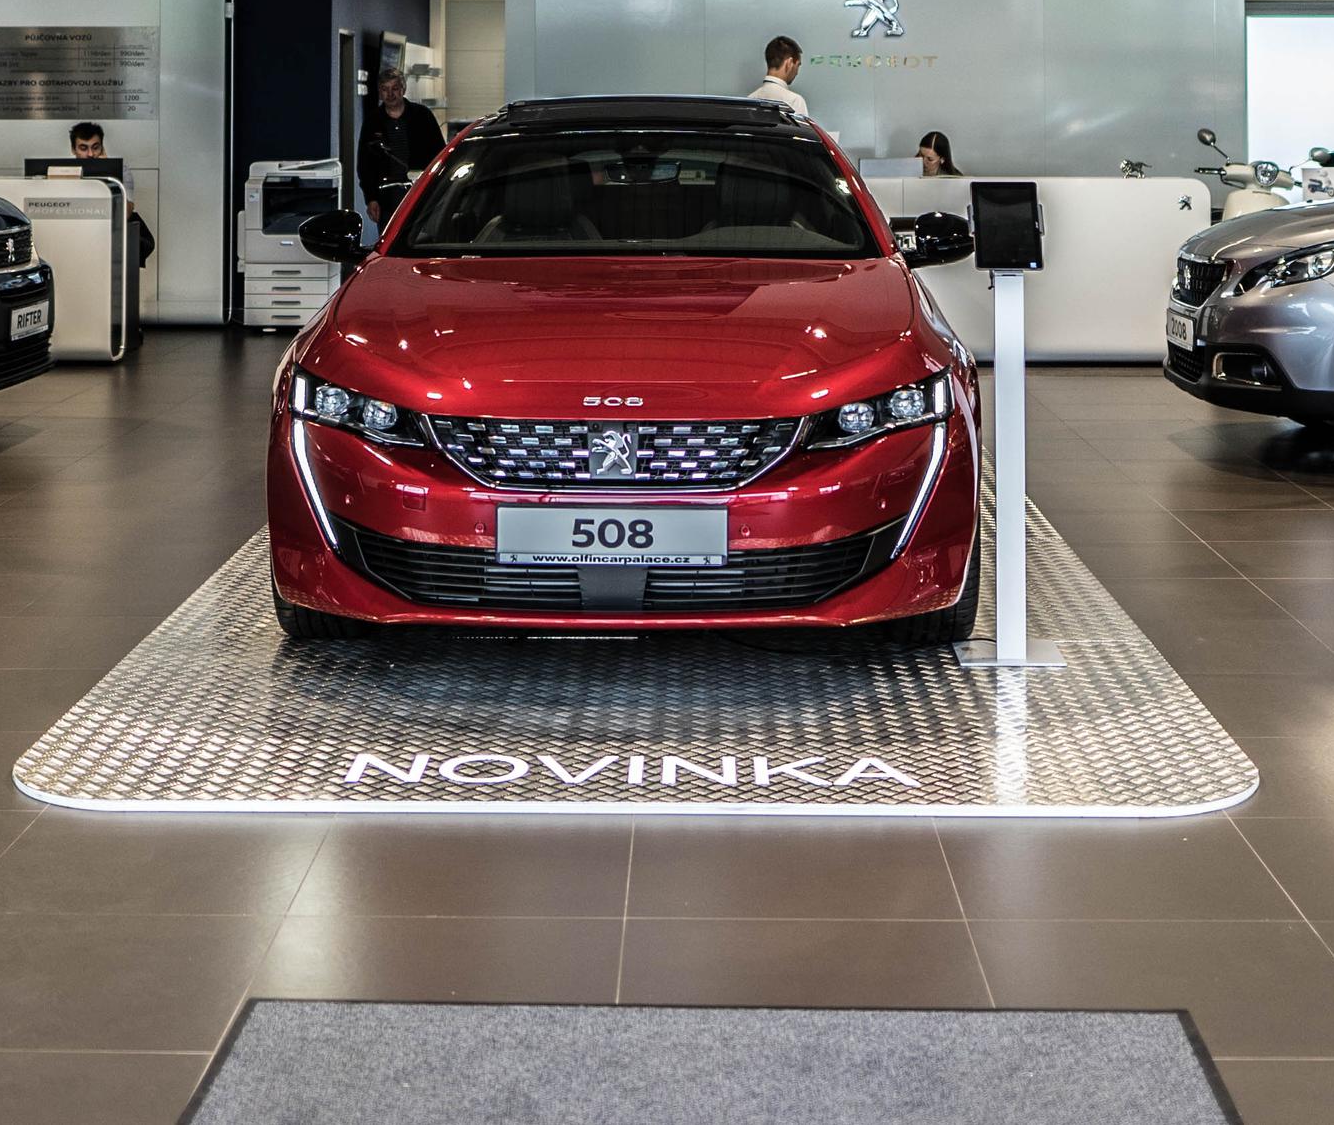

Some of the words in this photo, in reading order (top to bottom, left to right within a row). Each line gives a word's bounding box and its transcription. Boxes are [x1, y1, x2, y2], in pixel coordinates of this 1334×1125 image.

[17, 309, 41, 329] RIFTER
[1171, 317, 1187, 340] 2008
[582, 396, 644, 407] 508
[571, 518, 654, 549] 508
[532, 554, 690, 565] www.olfincarpalace.cz
[343, 753, 922, 788] NOVINKA
